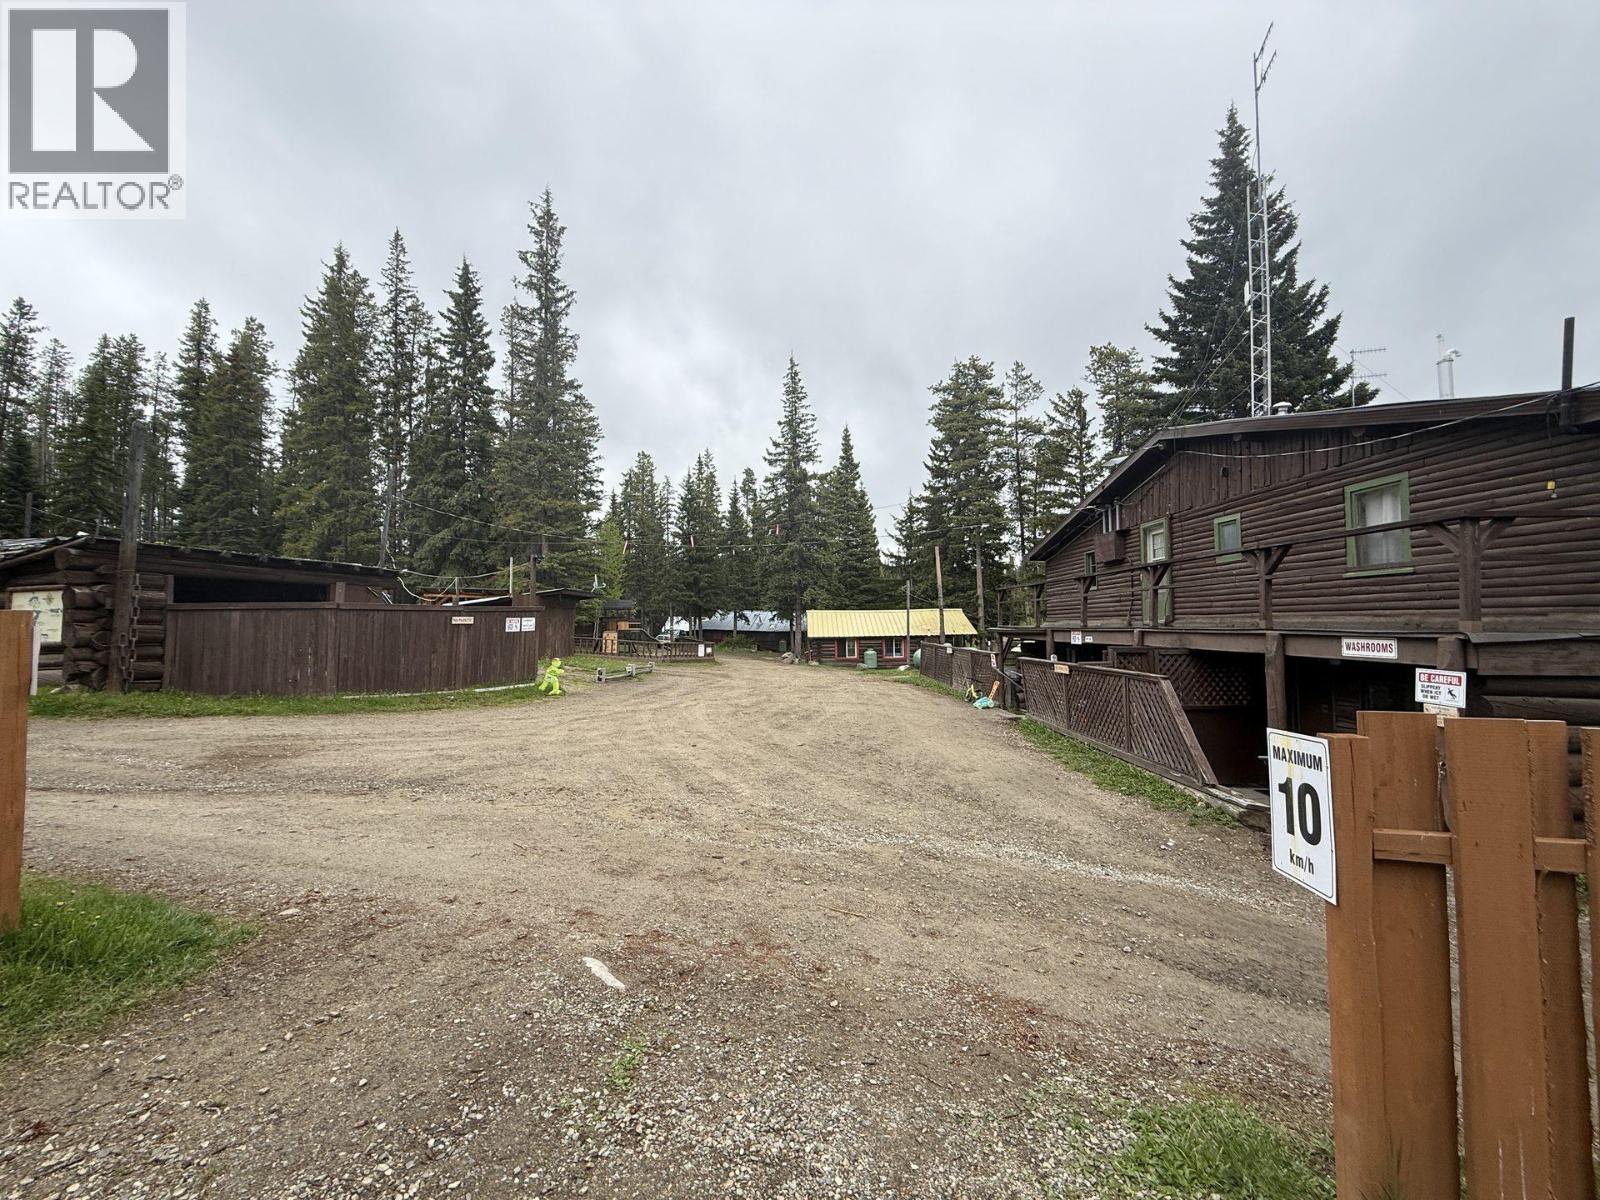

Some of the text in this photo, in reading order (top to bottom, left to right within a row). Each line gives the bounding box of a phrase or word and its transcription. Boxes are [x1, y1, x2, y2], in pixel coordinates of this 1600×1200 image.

[1344, 641, 1394, 654] WASHROOMS
[1420, 673, 1460, 685] BE CAREFUL
[1272, 745, 1323, 772] MAXIMUM
[1278, 776, 1322, 846] 10
[1289, 848, 1315, 875] km/h
